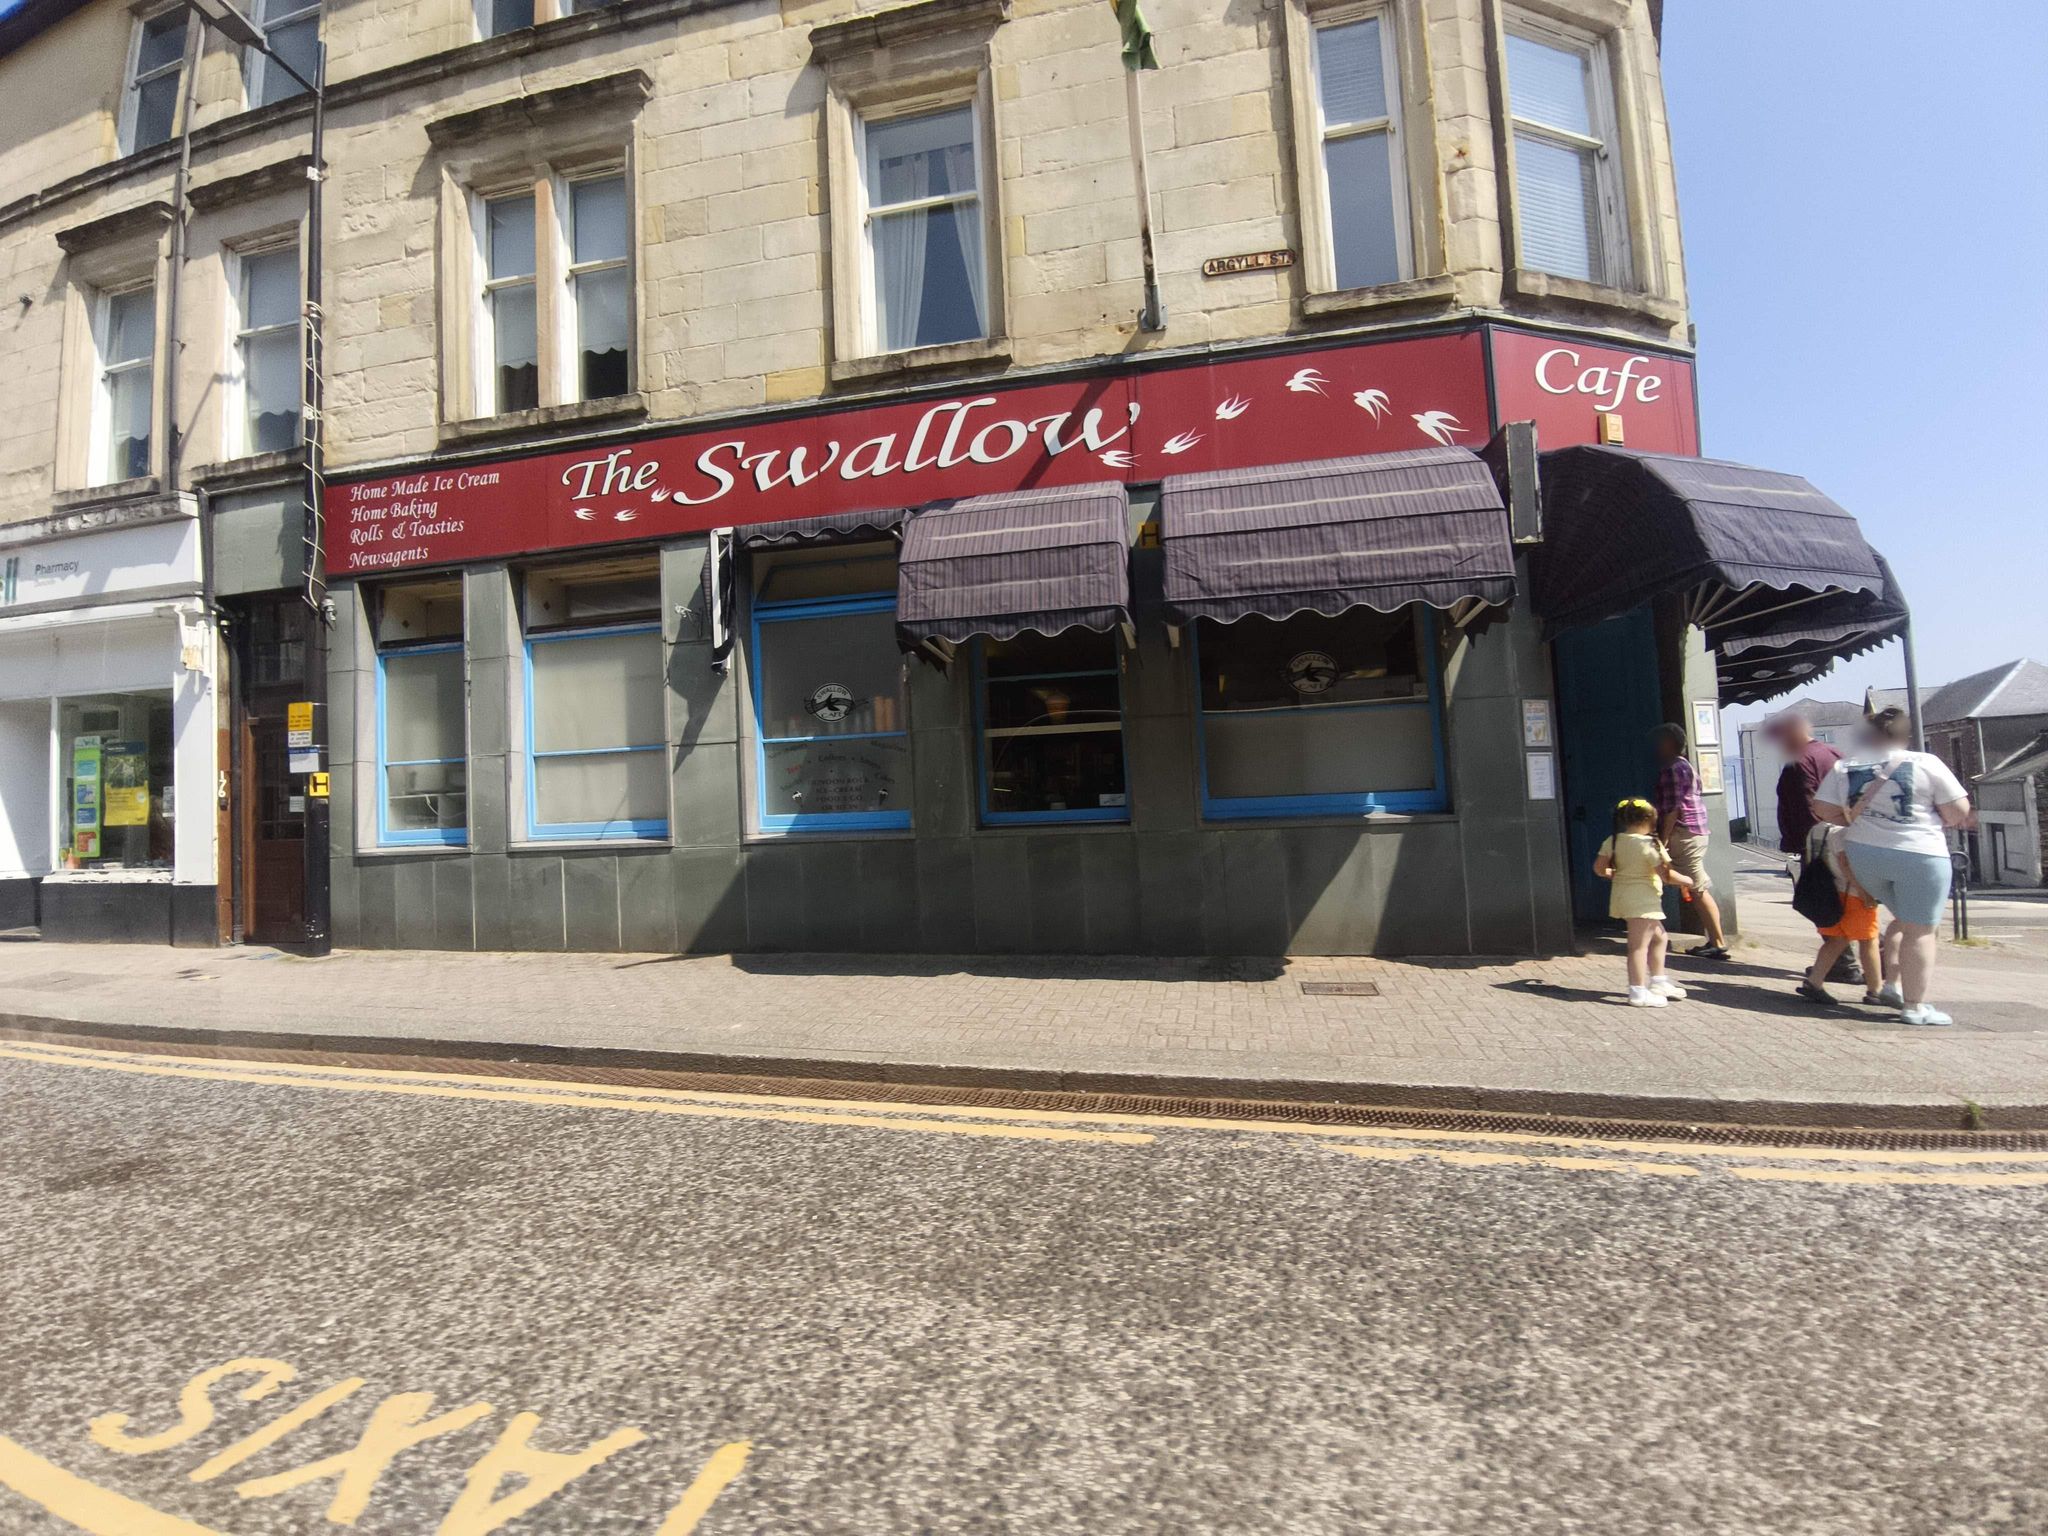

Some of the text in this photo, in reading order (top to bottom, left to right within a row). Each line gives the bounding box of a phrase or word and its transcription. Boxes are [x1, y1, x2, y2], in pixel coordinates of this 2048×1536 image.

[1208, 257, 1264, 273] ARGYLL
[1535, 349, 1662, 412] Cafe
[561, 397, 1141, 506] The Swallow
[350, 470, 500, 501] Home Made Ice Cream
[350, 499, 438, 523] Home Baking
[349, 517, 464, 546] Rolls & Toasties
[34, 560, 79, 574] Pharmacy
[348, 545, 429, 569] Newsagents
[816, 686, 849, 700] SWALLOW
[218, 769, 227, 798] 176
[312, 776, 329, 793] H
